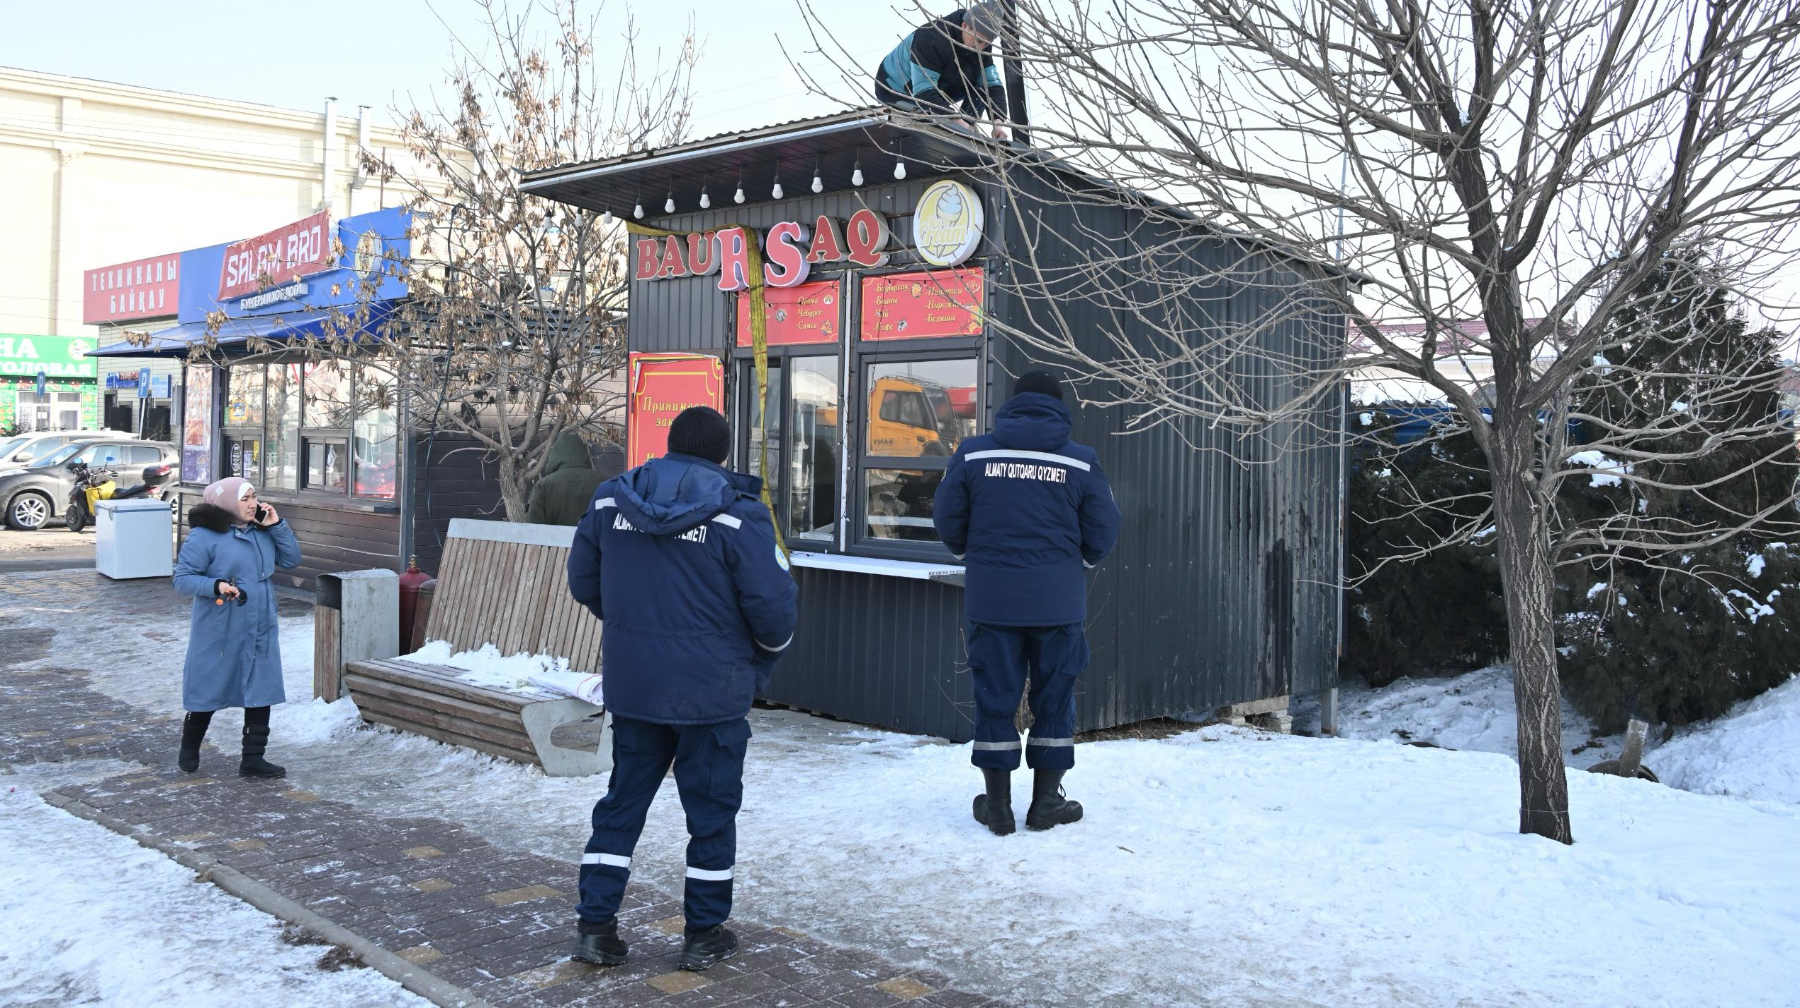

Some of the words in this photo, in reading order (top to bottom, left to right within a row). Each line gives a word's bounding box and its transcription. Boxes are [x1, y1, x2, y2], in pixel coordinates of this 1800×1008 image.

[226, 240, 282, 288] SALAM
[286, 225, 321, 269] BRO
[636, 208, 882, 291] BAURSAQ
[92, 260, 176, 292] ТЕХНИКАЛЫ
[110, 288, 165, 314] БАЙҚАУ
[0, 361, 92, 376] ОЛОВАЯ
[985, 462, 1008, 478] ALMATY
[1007, 463, 1037, 480] QUTQARU
[1037, 466, 1067, 484] QYZMETI
